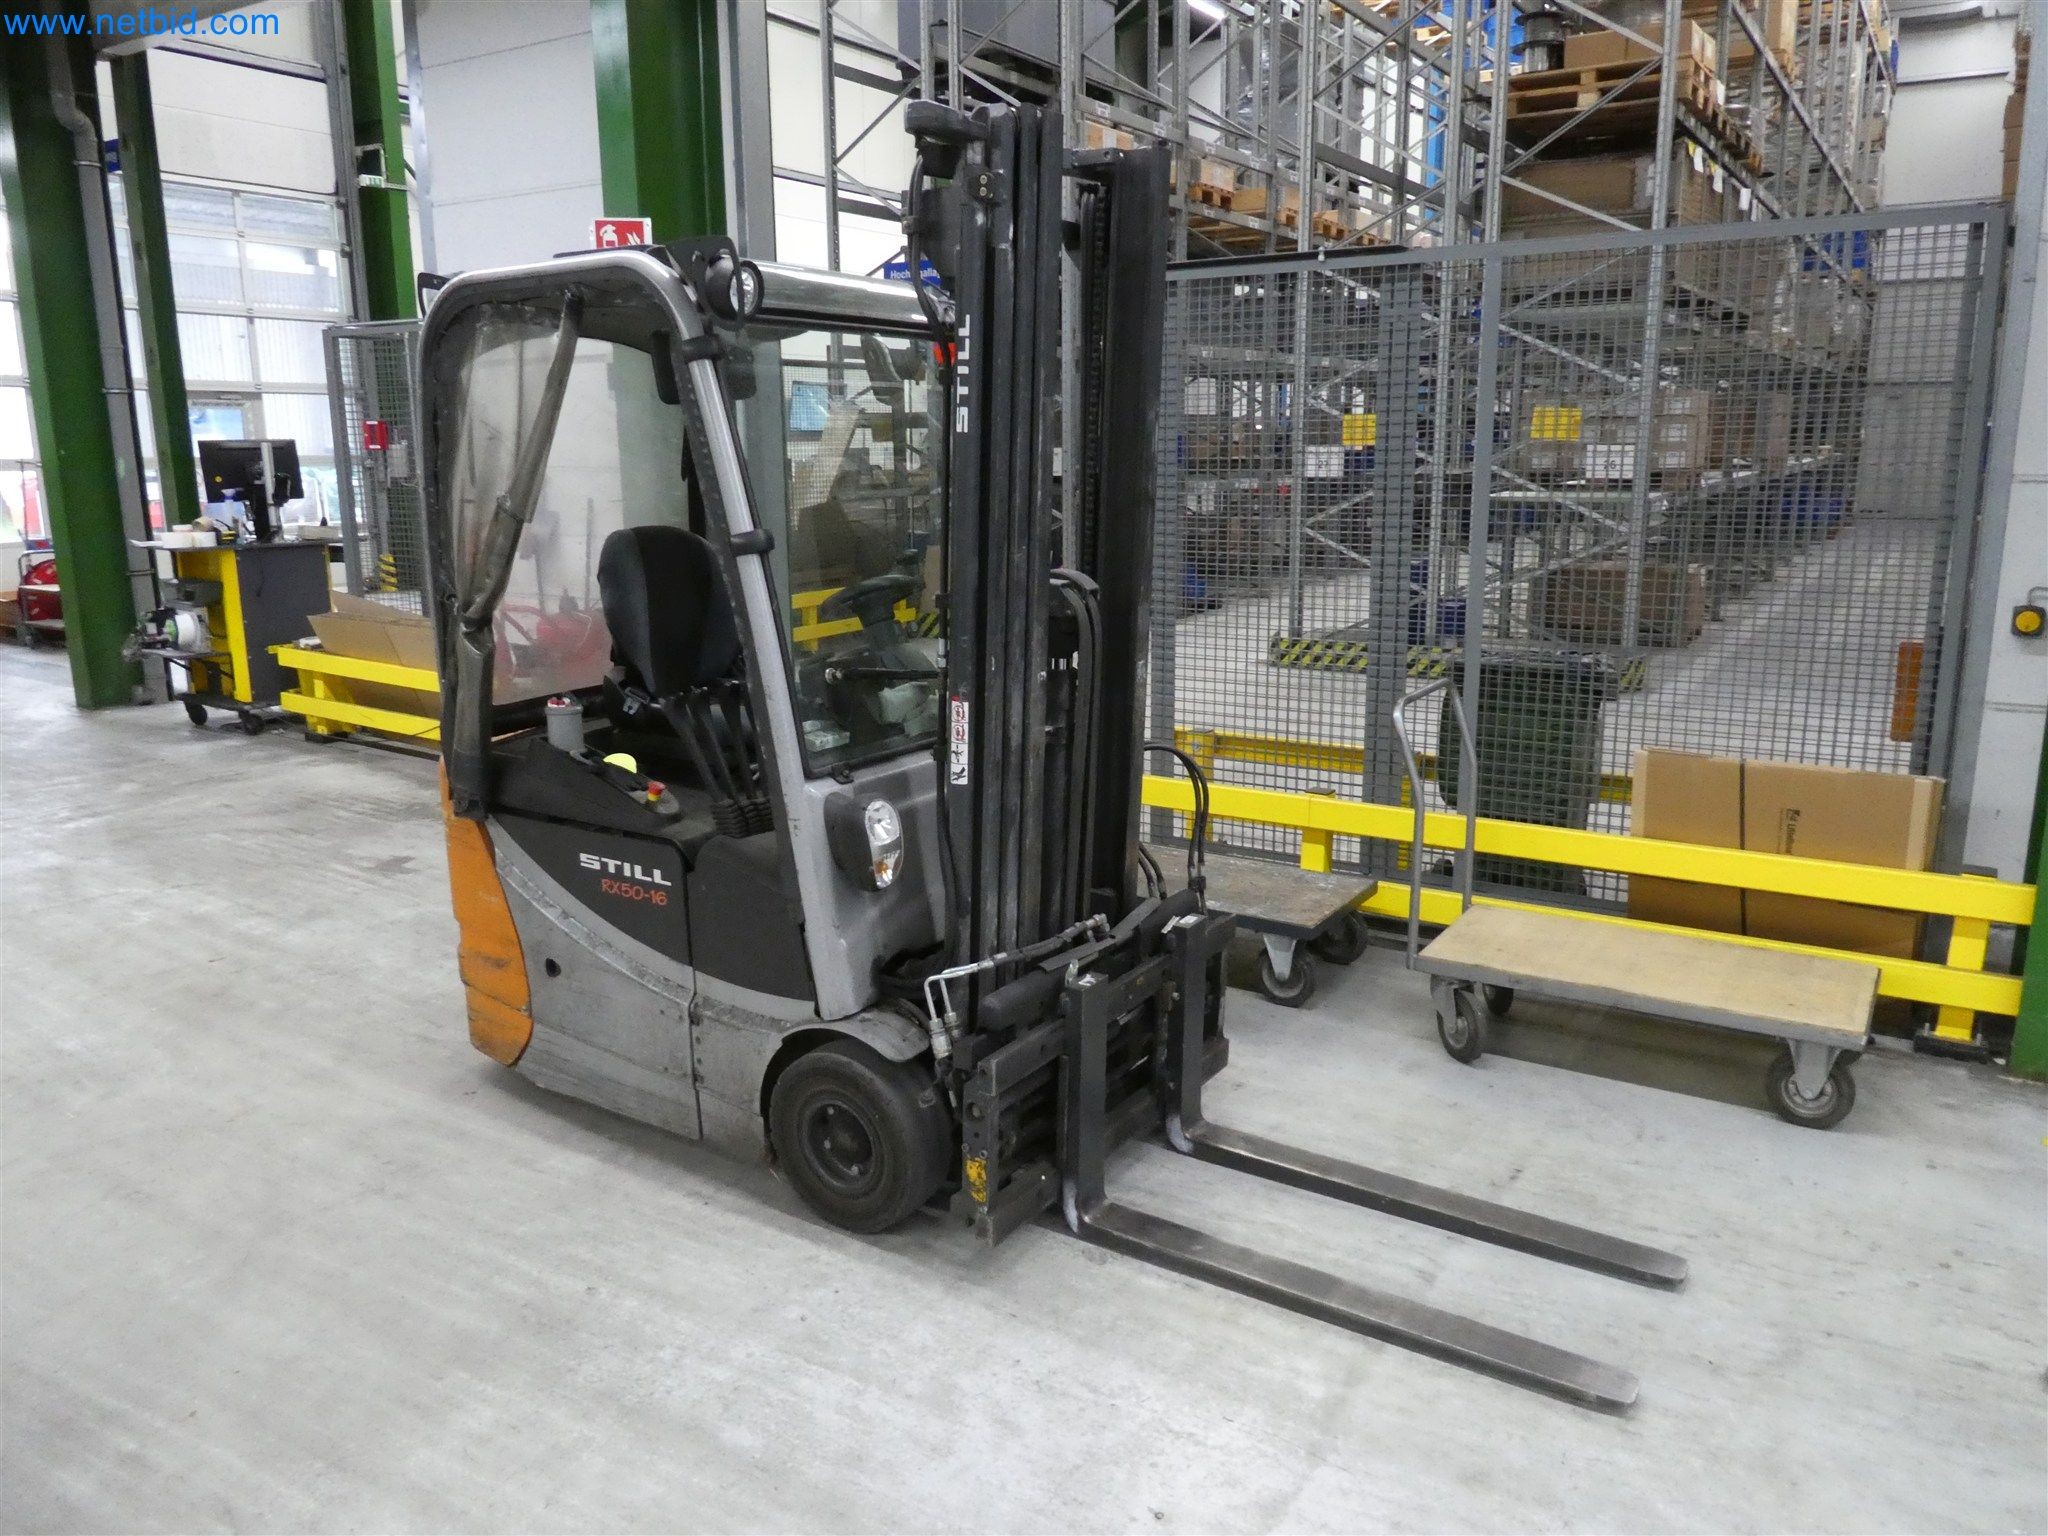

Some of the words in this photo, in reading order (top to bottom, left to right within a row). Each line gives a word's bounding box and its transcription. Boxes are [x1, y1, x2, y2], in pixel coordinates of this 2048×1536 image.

[956, 314, 970, 433] STILL
[580, 852, 672, 887] STILL
[602, 878, 668, 906] RX50-16
